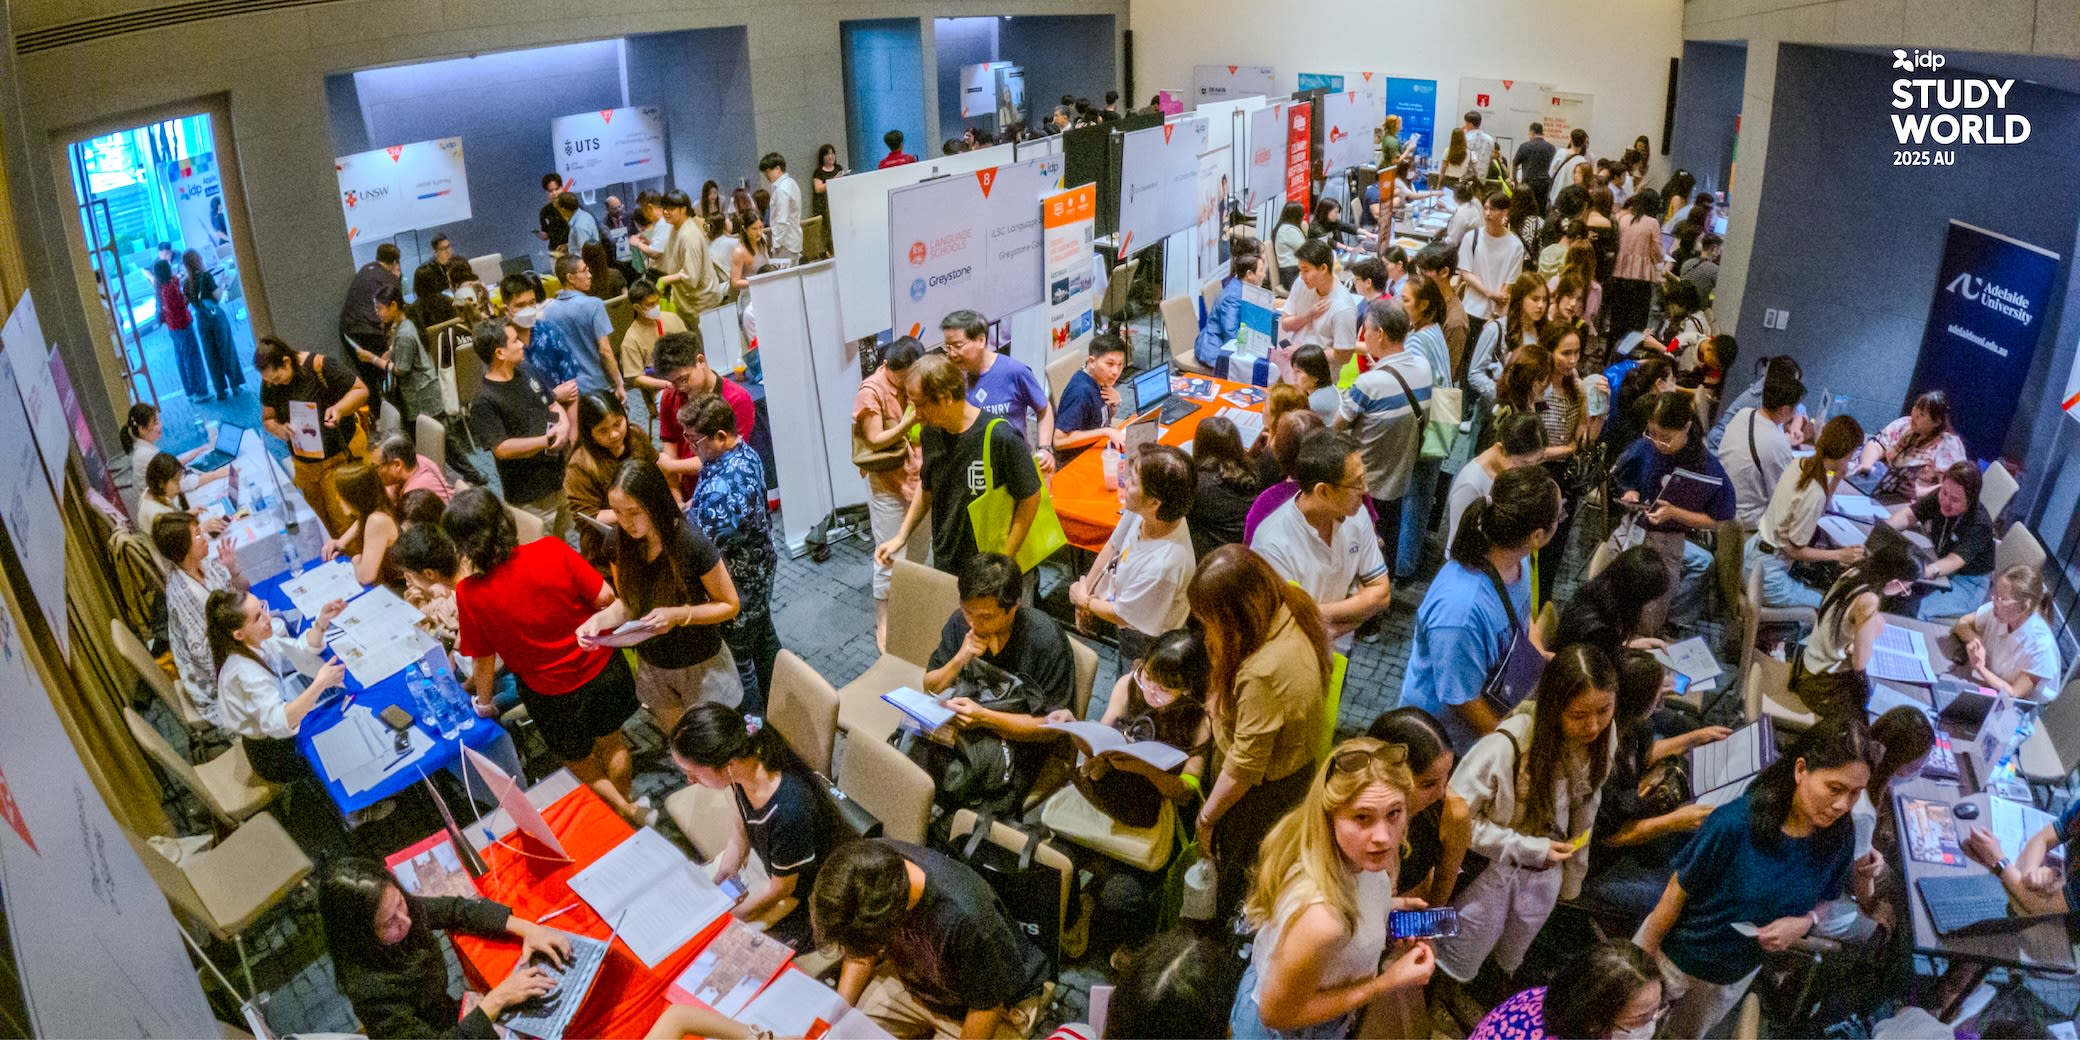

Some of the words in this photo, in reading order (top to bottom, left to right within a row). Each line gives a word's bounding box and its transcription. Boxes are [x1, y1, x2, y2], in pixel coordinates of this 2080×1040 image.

[575, 137, 600, 153] UTS
[1047, 161, 1059, 175] idp
[983, 172, 991, 186] 8
[189, 184, 202, 197] idp
[359, 186, 390, 201] UNSW
[1007, 217, 1038, 236] Language
[929, 229, 973, 249] LANGUAGE
[929, 240, 968, 260] SCHOOLS
[929, 264, 972, 288] Greystone
[1983, 281, 2030, 309] Adelaide
[1981, 293, 2033, 326] University
[982, 402, 1010, 415] ENRY
